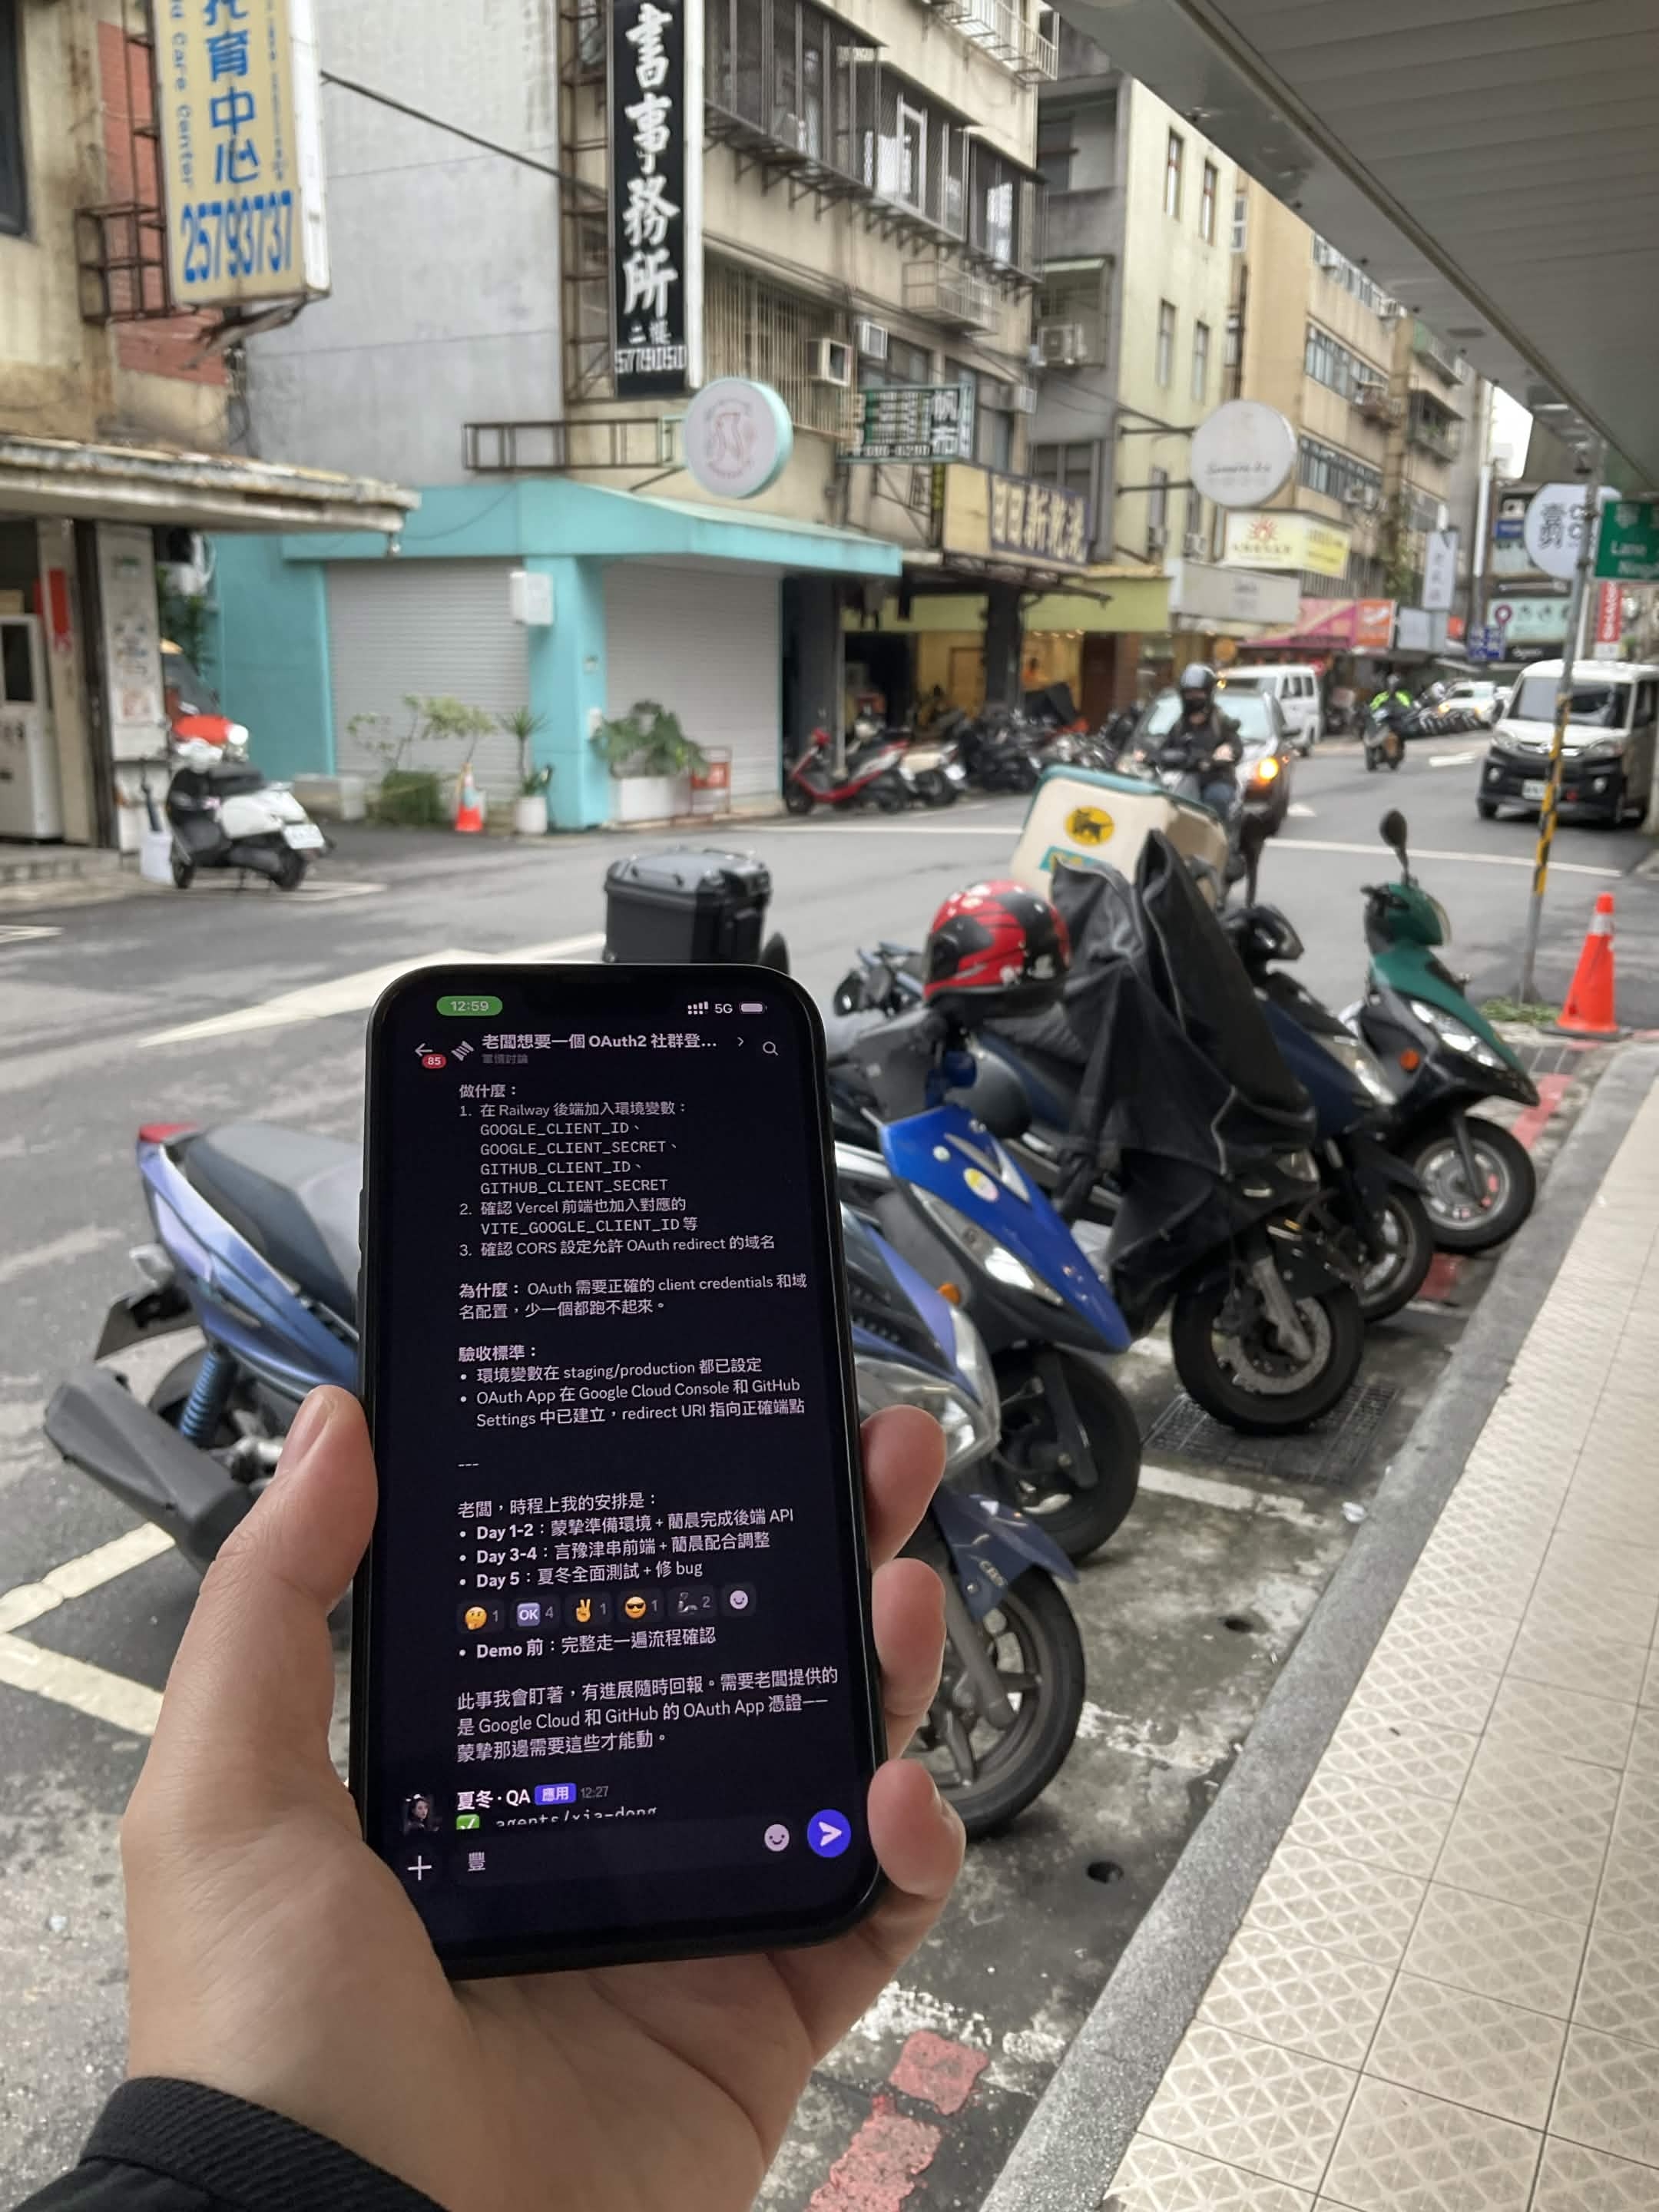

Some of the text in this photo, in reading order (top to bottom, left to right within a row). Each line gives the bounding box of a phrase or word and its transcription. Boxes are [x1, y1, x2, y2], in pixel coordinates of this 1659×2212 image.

[171, 32, 187, 91] Care
[177, 104, 194, 189] Center
[621, 2, 681, 317] 書事務所
[180, 189, 293, 284] 25793737
[450, 1001, 489, 1012] 12:59
[714, 1003, 733, 1014] 5G
[482, 1033, 585, 1050] 老闆想要一個
[588, 1034, 647, 1048] OAuth2
[427, 1057, 441, 1065] 85
[459, 1083, 516, 1098] 做什麼：
[459, 1101, 685, 1118] 1. 在 Railway 後端加入環境變數：
[480, 1178, 668, 1194] GITHUB_CLIENT_SECRET
[459, 1197, 686, 1216] 2. 確認 Vercel 前端也加入對應的
[480, 1216, 698, 1236] VITE_GOOGLE_CLIENT_ID 等
[459, 1234, 775, 1257] 3. 確認 CORS 設定允許 OAuth redirect 的域名
[527, 1281, 572, 1296] OAuth
[575, 1277, 654, 1295] 需要正確的
[657, 1277, 696, 1291] client
[699, 1275, 773, 1290] credentials
[776, 1273, 808, 1289] 和域
[476, 1356, 763, 1383] 環境變數在 staging/production 都已設定
[476, 1377, 800, 1405] OAuth App 在 Google Cloud Console 和 GitHub
[476, 1412, 536, 1429] Settings
[681, 1404, 706, 1418] URI
[709, 1397, 805, 1418] 指向正確端點
[477, 1525, 506, 1542] Day
[769, 1508, 793, 1523] API
[476, 1549, 506, 1566] Day
[476, 1574, 506, 1590] Day
[655, 1560, 672, 1578] 修
[676, 1561, 703, 1578] bug
[600, 1603, 606, 1615] 1
[651, 1599, 657, 1612] 1
[702, 1595, 711, 1608] 2
[492, 1609, 498, 1623] 1
[519, 1606, 554, 1621] OK 4
[476, 1644, 522, 1659] Demo
[457, 1717, 475, 1737] 是
[478, 1714, 532, 1735] Google
[535, 1710, 580, 1729] Cloud
[584, 1708, 601, 1727] 和
[605, 1705, 659, 1724] GitHub
[663, 1701, 680, 1720] 的
[683, 1700, 730, 1718] OAuth
[734, 1699, 765, 1717] App
[457, 1790, 494, 1811] 夏冬
[505, 1789, 531, 1806] QA
[541, 1785, 569, 1802] 應用
[580, 1785, 609, 1799] 12:27
[468, 1851, 486, 1872] 豐
